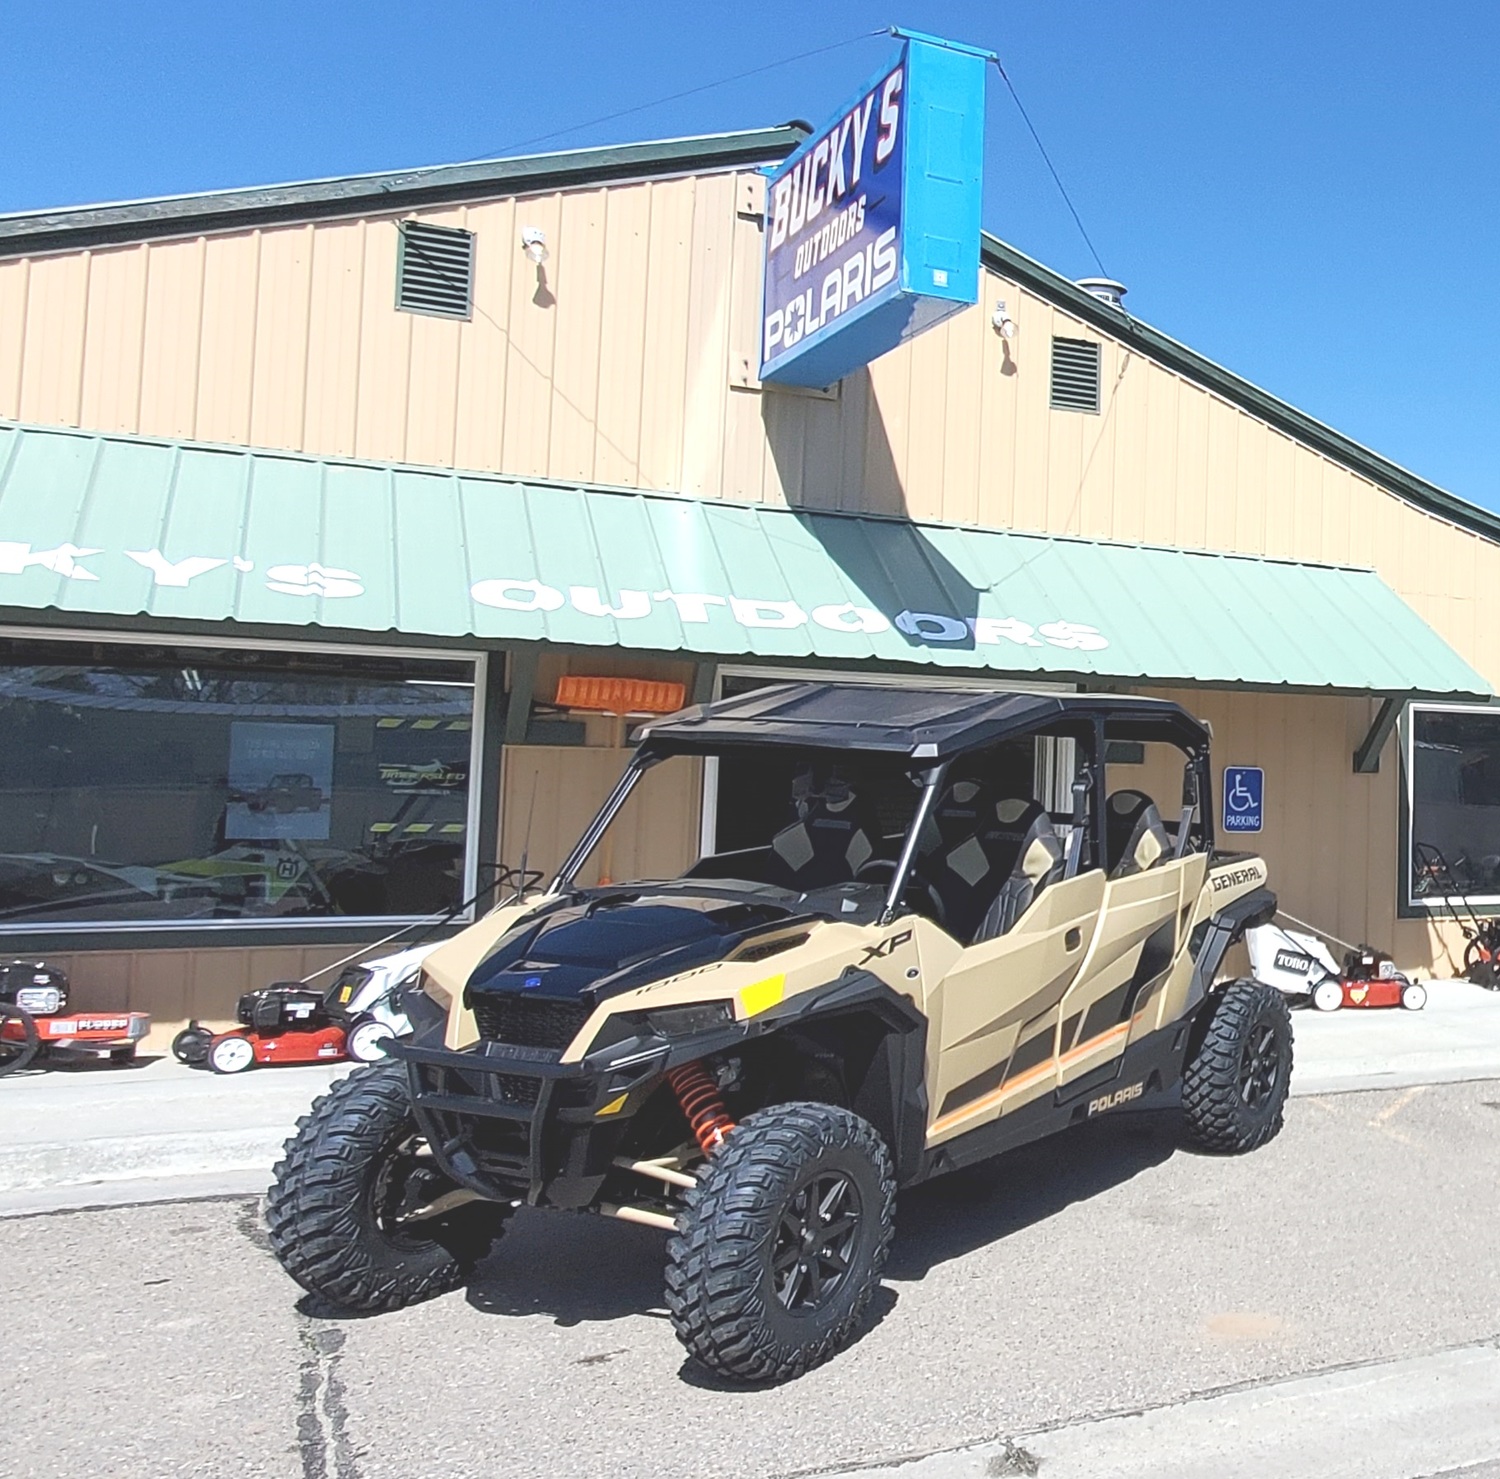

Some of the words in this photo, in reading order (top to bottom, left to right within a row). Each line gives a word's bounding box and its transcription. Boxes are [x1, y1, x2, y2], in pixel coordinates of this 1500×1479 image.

[794, 194, 868, 280] OUTDOORS
[764, 226, 897, 362] POLARIS
[470, 578, 1109, 651] OUTDOORS
[1226, 815, 1260, 827] PARKING
[1211, 866, 1263, 892] GENERAL
[858, 930, 912, 965] XP
[1277, 954, 1308, 971] TORO
[635, 963, 723, 997] 1000
[1087, 1081, 1143, 1117] POLARIS
